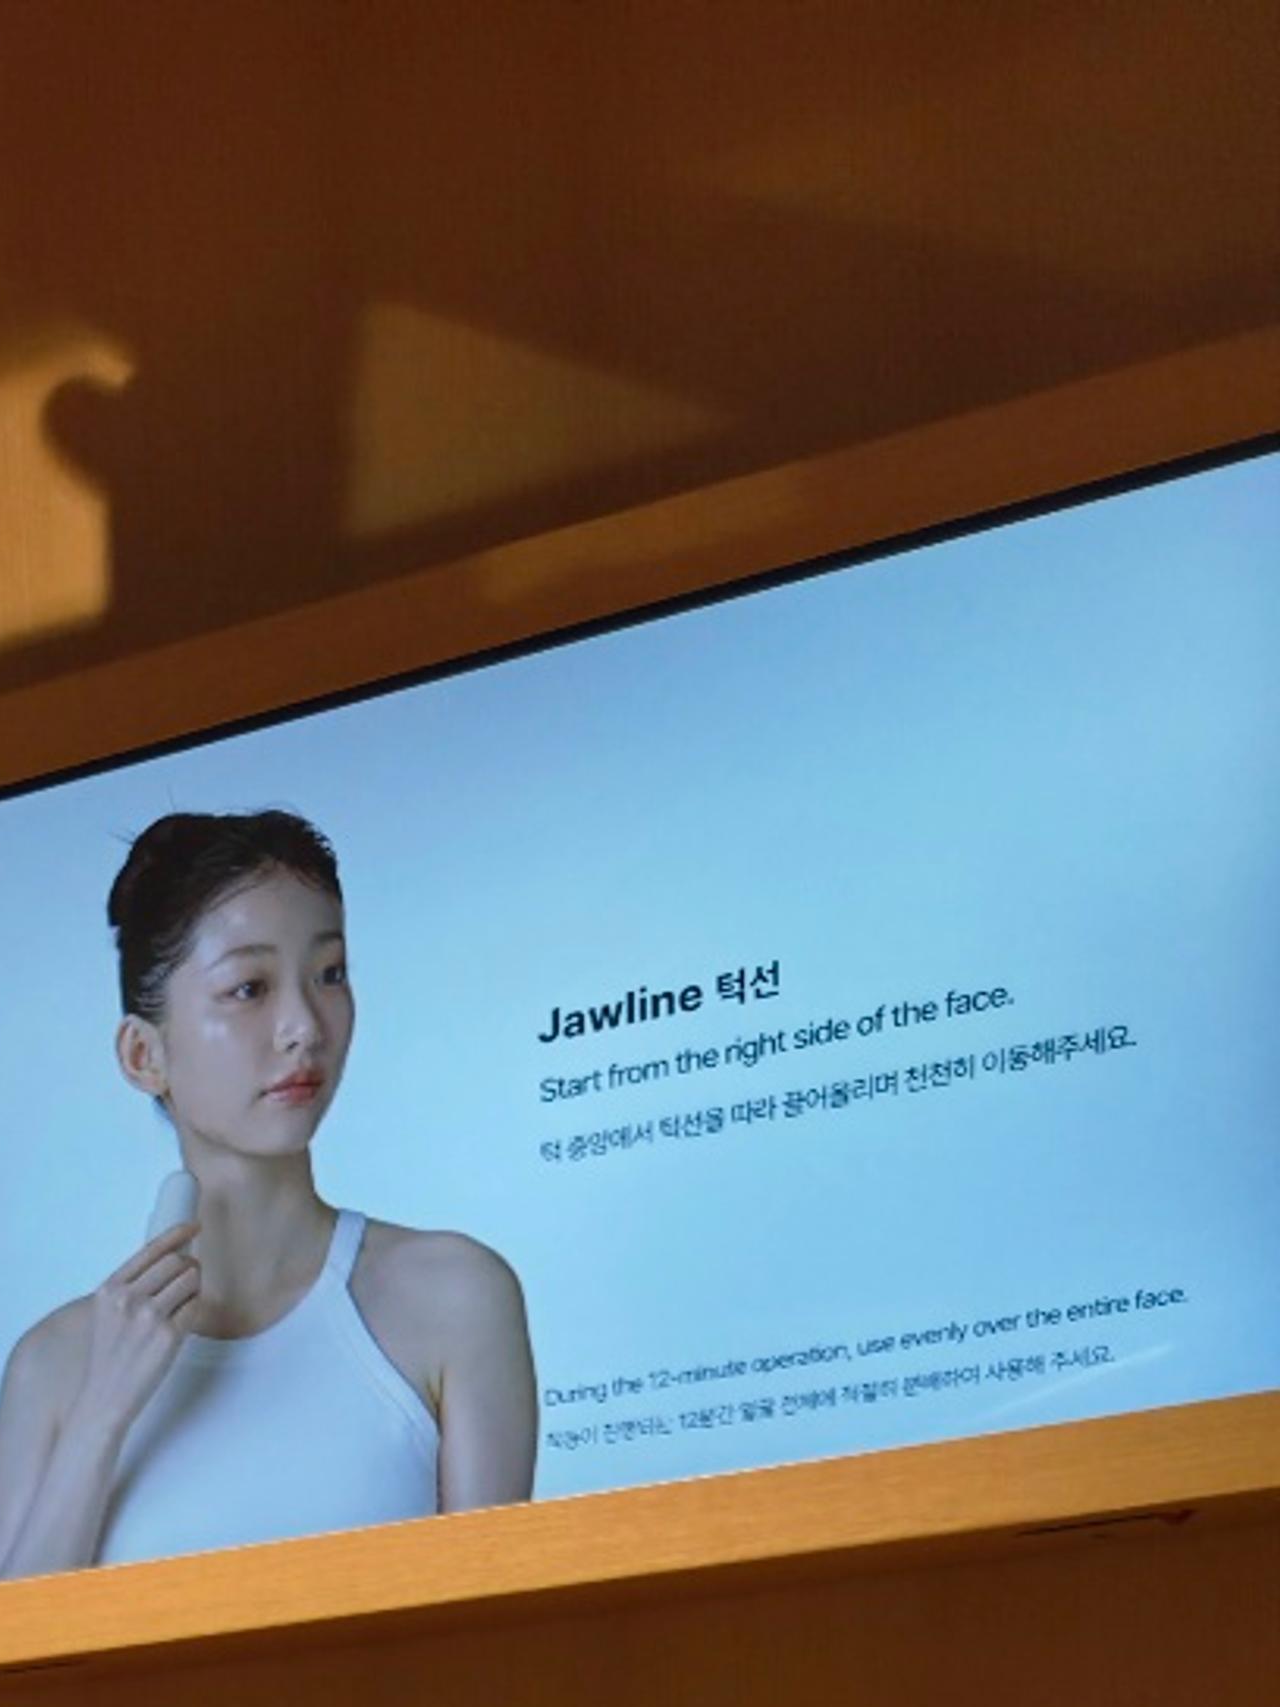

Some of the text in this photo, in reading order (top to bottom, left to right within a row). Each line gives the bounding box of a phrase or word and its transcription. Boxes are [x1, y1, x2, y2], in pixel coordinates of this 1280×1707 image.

[538, 960, 780, 1043] Jawline 턱선
[540, 986, 1014, 1103] Start from the right side of the face.
[731, 1096, 776, 1123] 따라
[904, 1052, 976, 1092] 천천히
[544, 1381, 608, 1407] During
[612, 1374, 643, 1396] the
[647, 1358, 747, 1388] 12-minute
[751, 1342, 852, 1373] operation,
[857, 1335, 896, 1357] use
[900, 1322, 969, 1350] evenly
[972, 1313, 1022, 1338] over
[1025, 1306, 1062, 1329] the
[1066, 1293, 1132, 1322] entire
